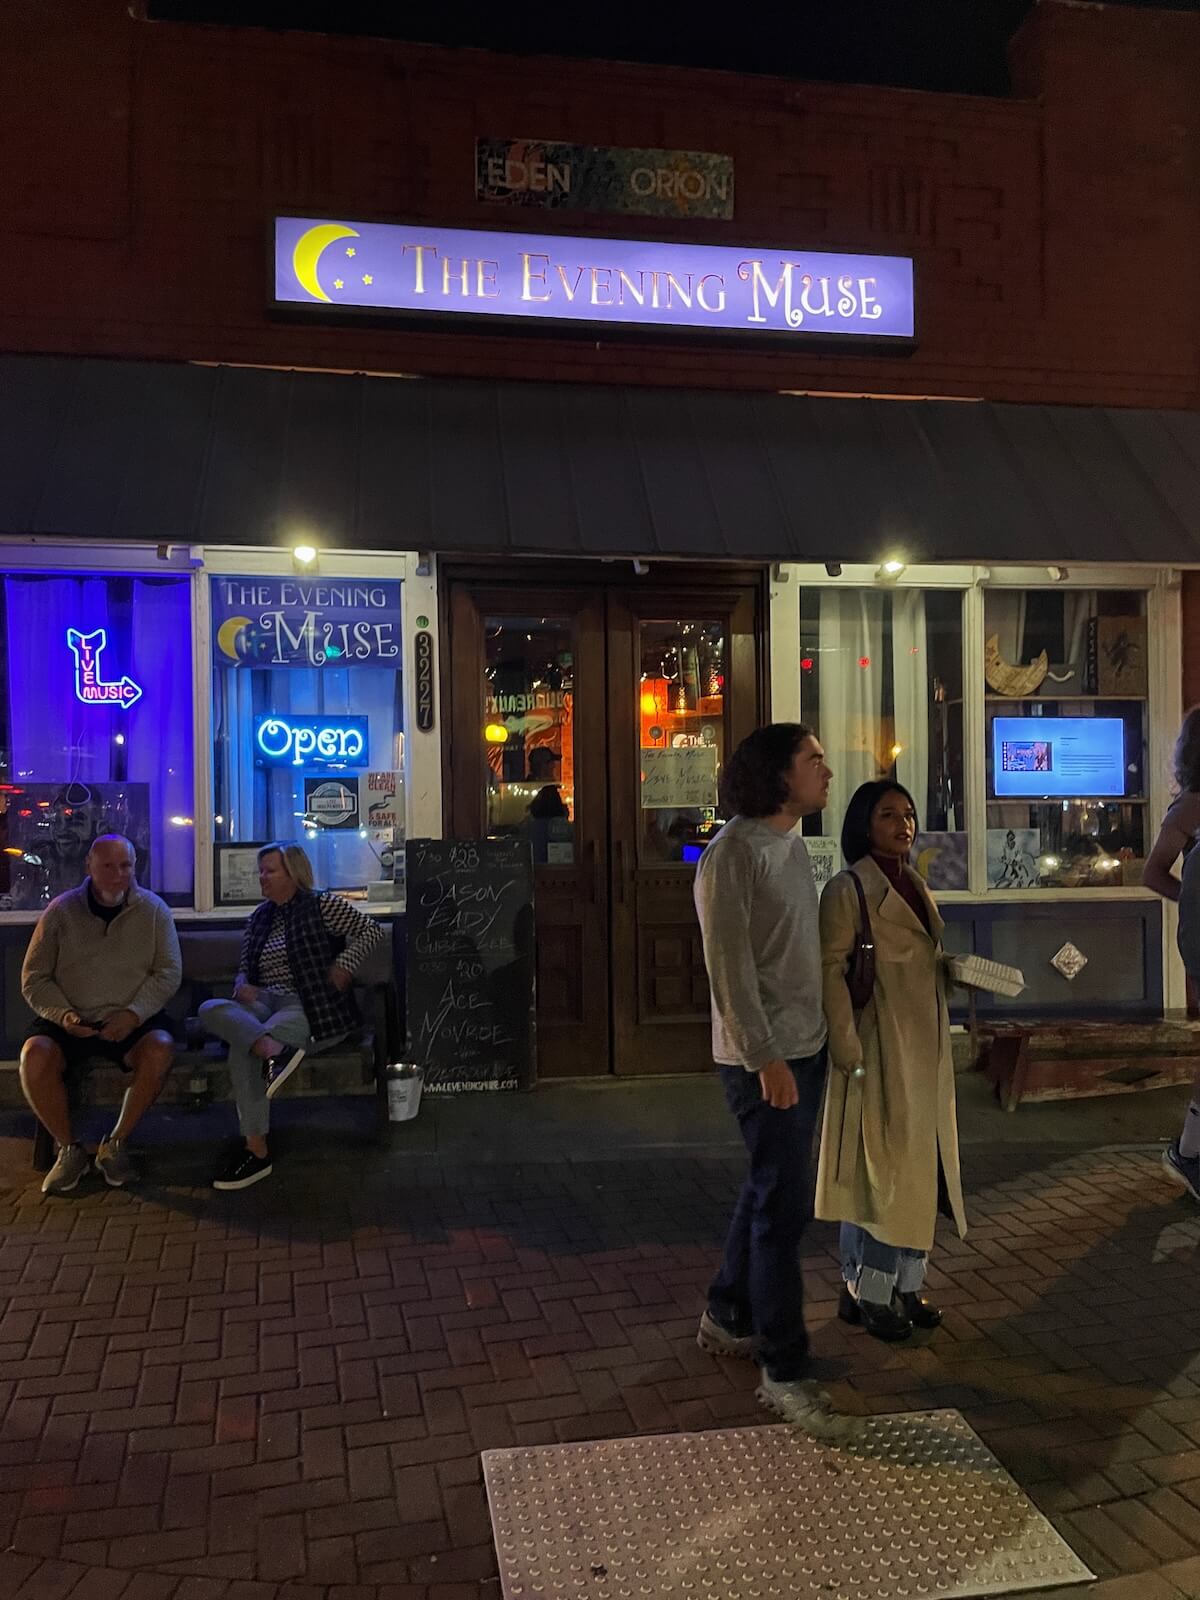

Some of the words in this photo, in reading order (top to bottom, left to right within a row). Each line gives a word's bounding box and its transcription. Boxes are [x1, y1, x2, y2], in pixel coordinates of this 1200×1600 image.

[487, 159, 571, 193] EDEN
[631, 168, 729, 200] ORION
[403, 244, 499, 298] THE
[519, 252, 726, 313] EVENING
[737, 259, 883, 329] MUSE
[220, 581, 273, 607] THE
[280, 582, 386, 608] EVENING
[259, 610, 399, 667] MUSE
[81, 638, 94, 684] LIVE
[83, 686, 134, 699] MUSIC
[418, 632, 432, 728] 3227
[257, 718, 364, 766] Open
[420, 871, 515, 907] JASON
[440, 979, 494, 1010] ACE
